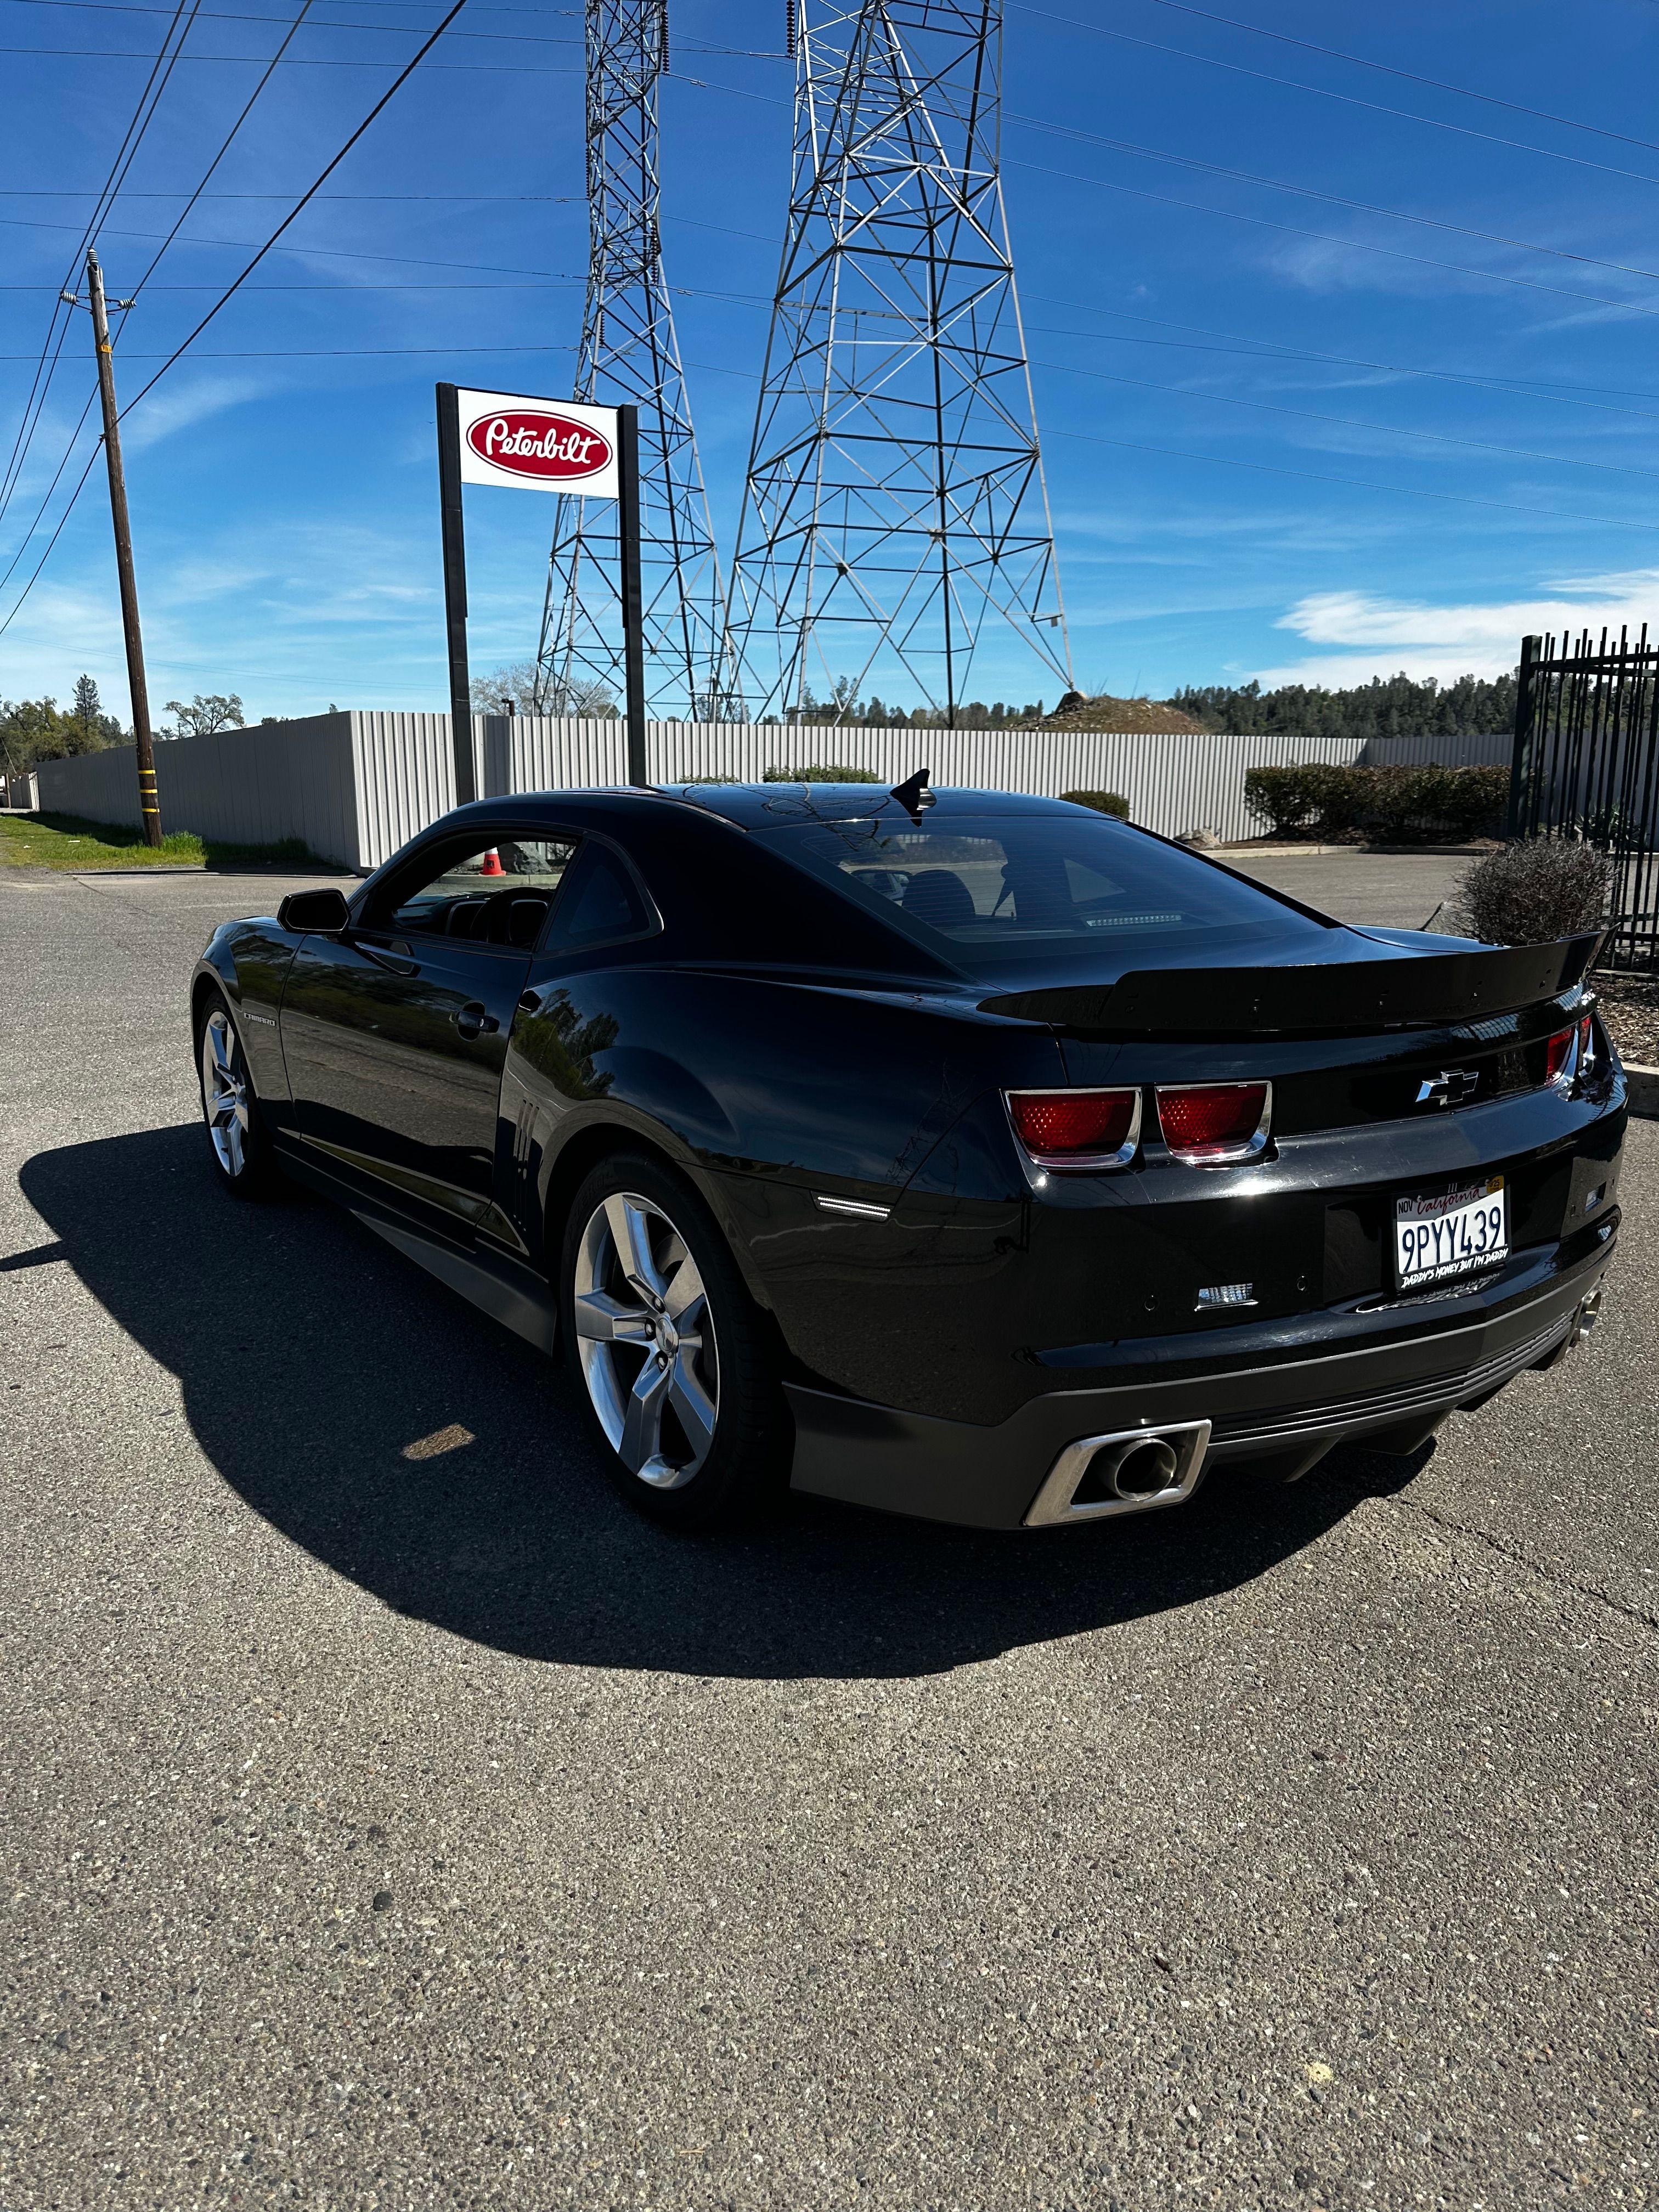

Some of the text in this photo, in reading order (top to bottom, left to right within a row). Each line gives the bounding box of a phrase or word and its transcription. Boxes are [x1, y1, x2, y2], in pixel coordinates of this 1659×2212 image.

[486, 418, 601, 464] Peterbilt
[244, 1012, 275, 1026] CAMARO
[1398, 1200, 1413, 1214] NOV
[1417, 1188, 1488, 1215] California
[1402, 1206, 1501, 1273] 9PYY439
[1401, 1269, 1435, 1288] DADDY'S
[1435, 1261, 1459, 1279] MONEY
[1457, 1257, 1474, 1273] BUT
[1483, 1248, 1509, 1265] DADDY
